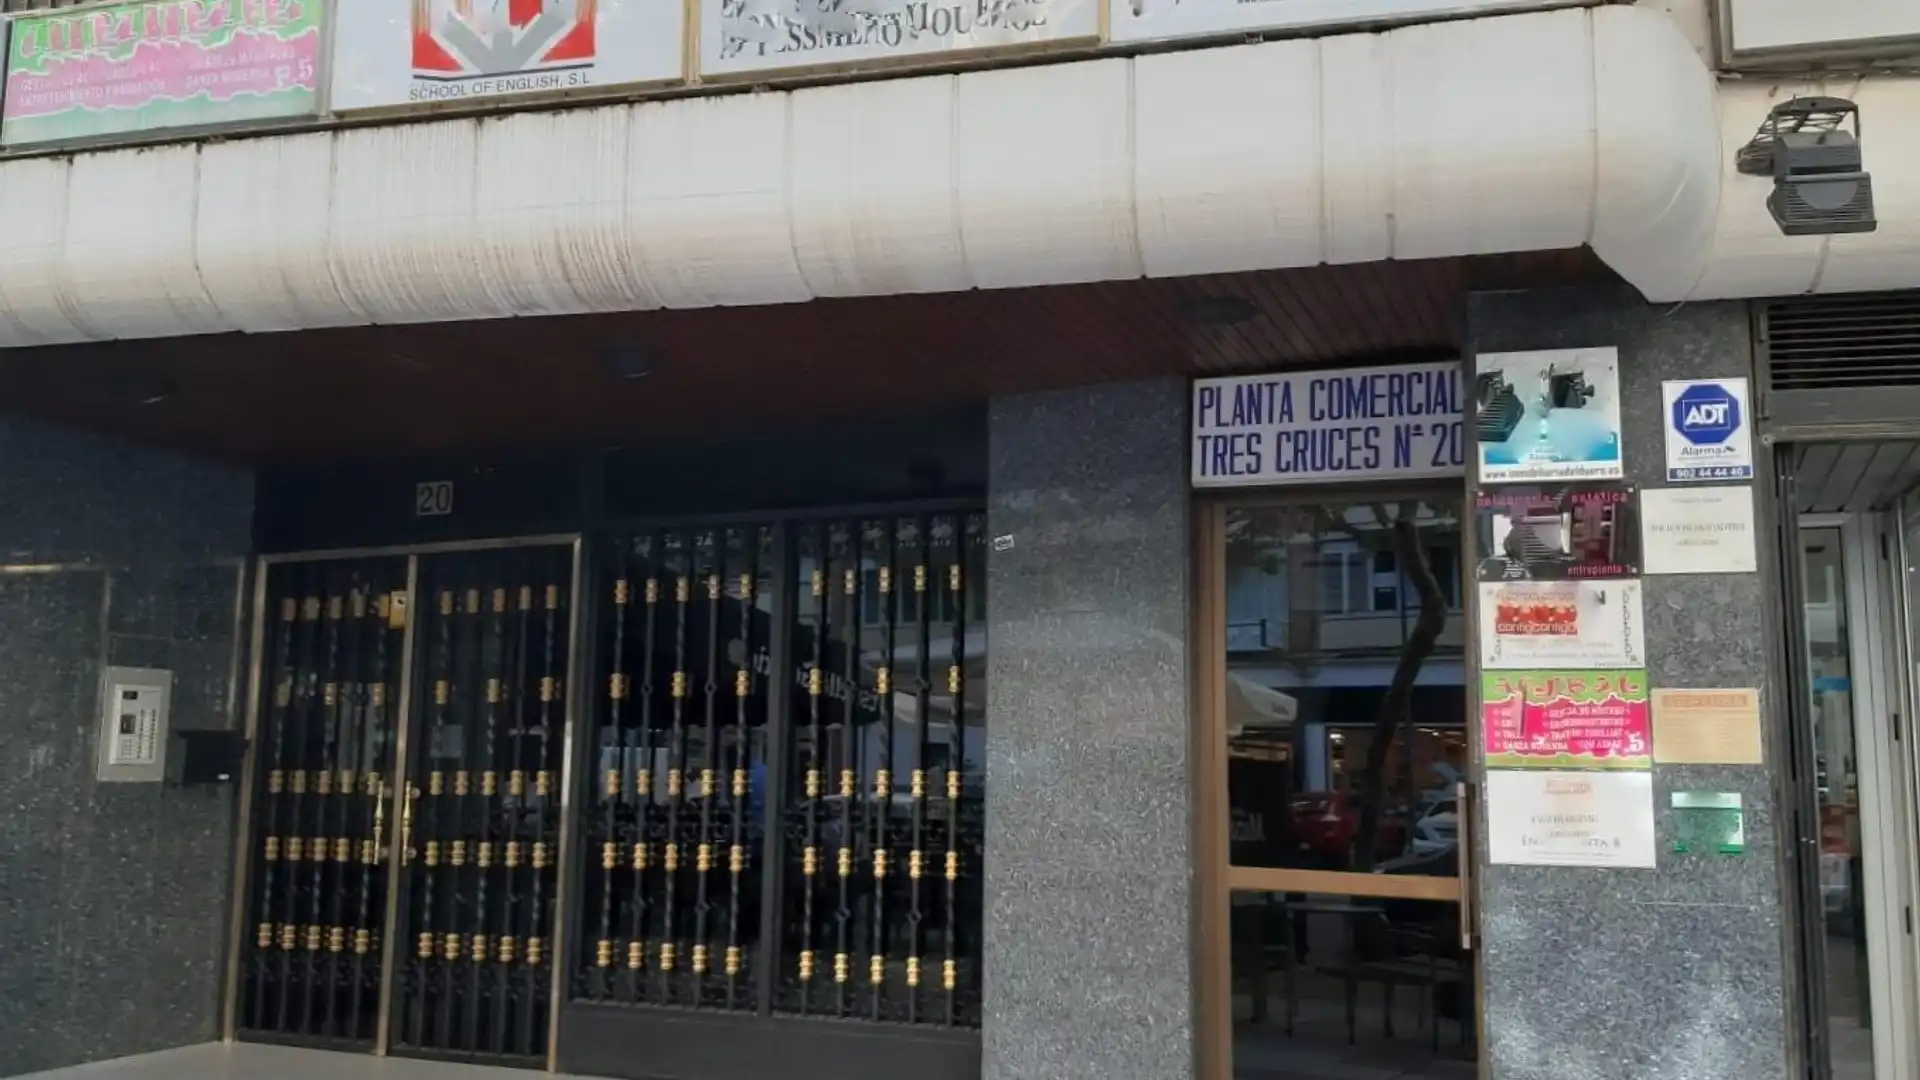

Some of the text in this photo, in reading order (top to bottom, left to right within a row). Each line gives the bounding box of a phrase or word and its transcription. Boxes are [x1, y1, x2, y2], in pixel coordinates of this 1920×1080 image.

[409, 82, 467, 100] SCHOOL
[472, 81, 491, 94] OF
[1198, 370, 1464, 428] PLANTA COMERCIAL
[1684, 404, 1729, 426] ADT
[1197, 433, 1262, 476] TRES
[1275, 426, 1381, 473] CRUCES
[1430, 421, 1465, 467] 20
[1676, 468, 1695, 478] 902
[1698, 467, 1712, 477] 44
[1714, 466, 1728, 476] 44
[420, 484, 450, 512] 20
